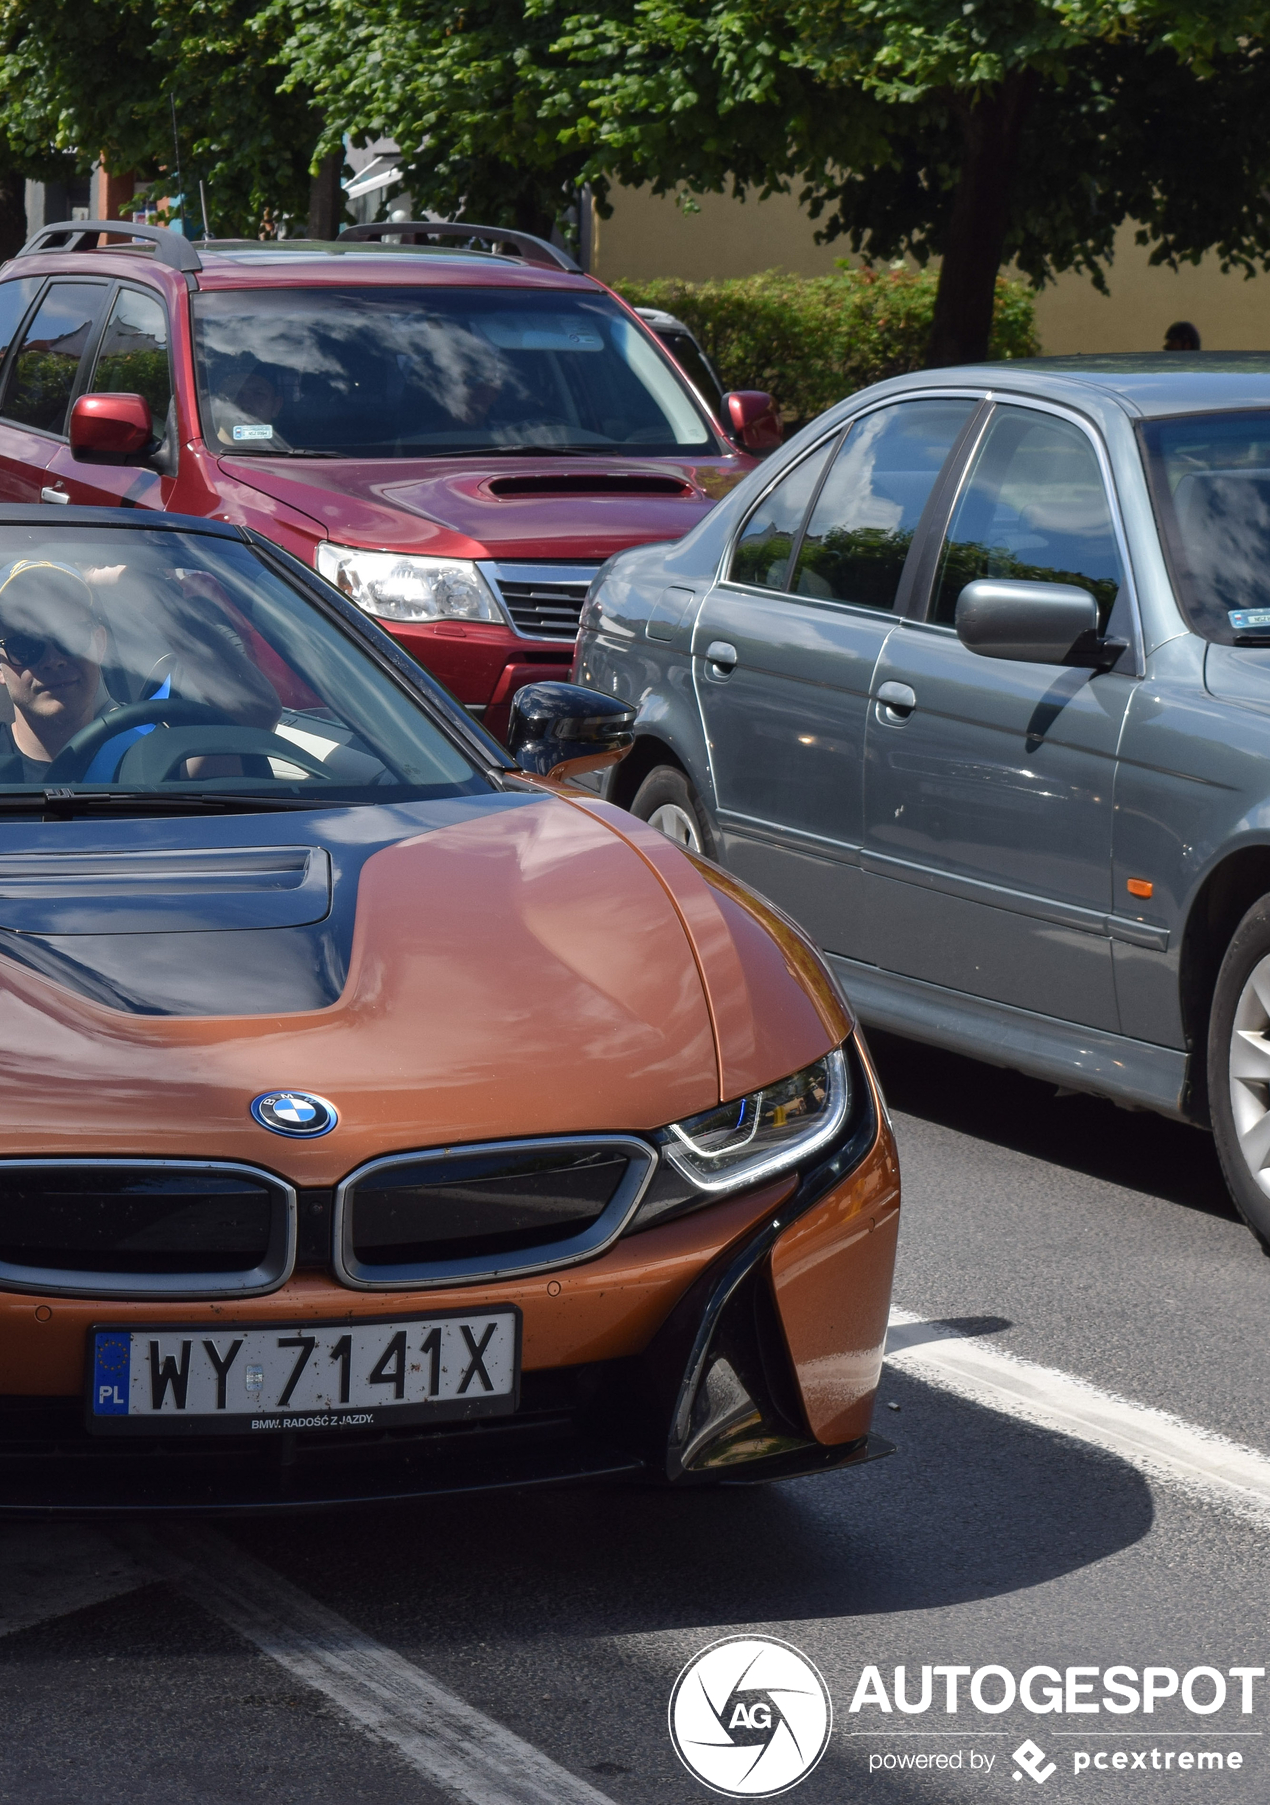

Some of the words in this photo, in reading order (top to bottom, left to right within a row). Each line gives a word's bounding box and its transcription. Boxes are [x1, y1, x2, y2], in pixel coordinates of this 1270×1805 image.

[263, 1093, 317, 1105] BMW
[149, 1339, 244, 1410] WY
[277, 1322, 497, 1406] 7141X
[99, 1386, 124, 1404] PL
[251, 1420, 281, 1429] BMW.
[283, 1416, 329, 1428] RADOŚĆ
[330, 1417, 337, 1426] Z
[339, 1415, 374, 1426] JAZDY.
